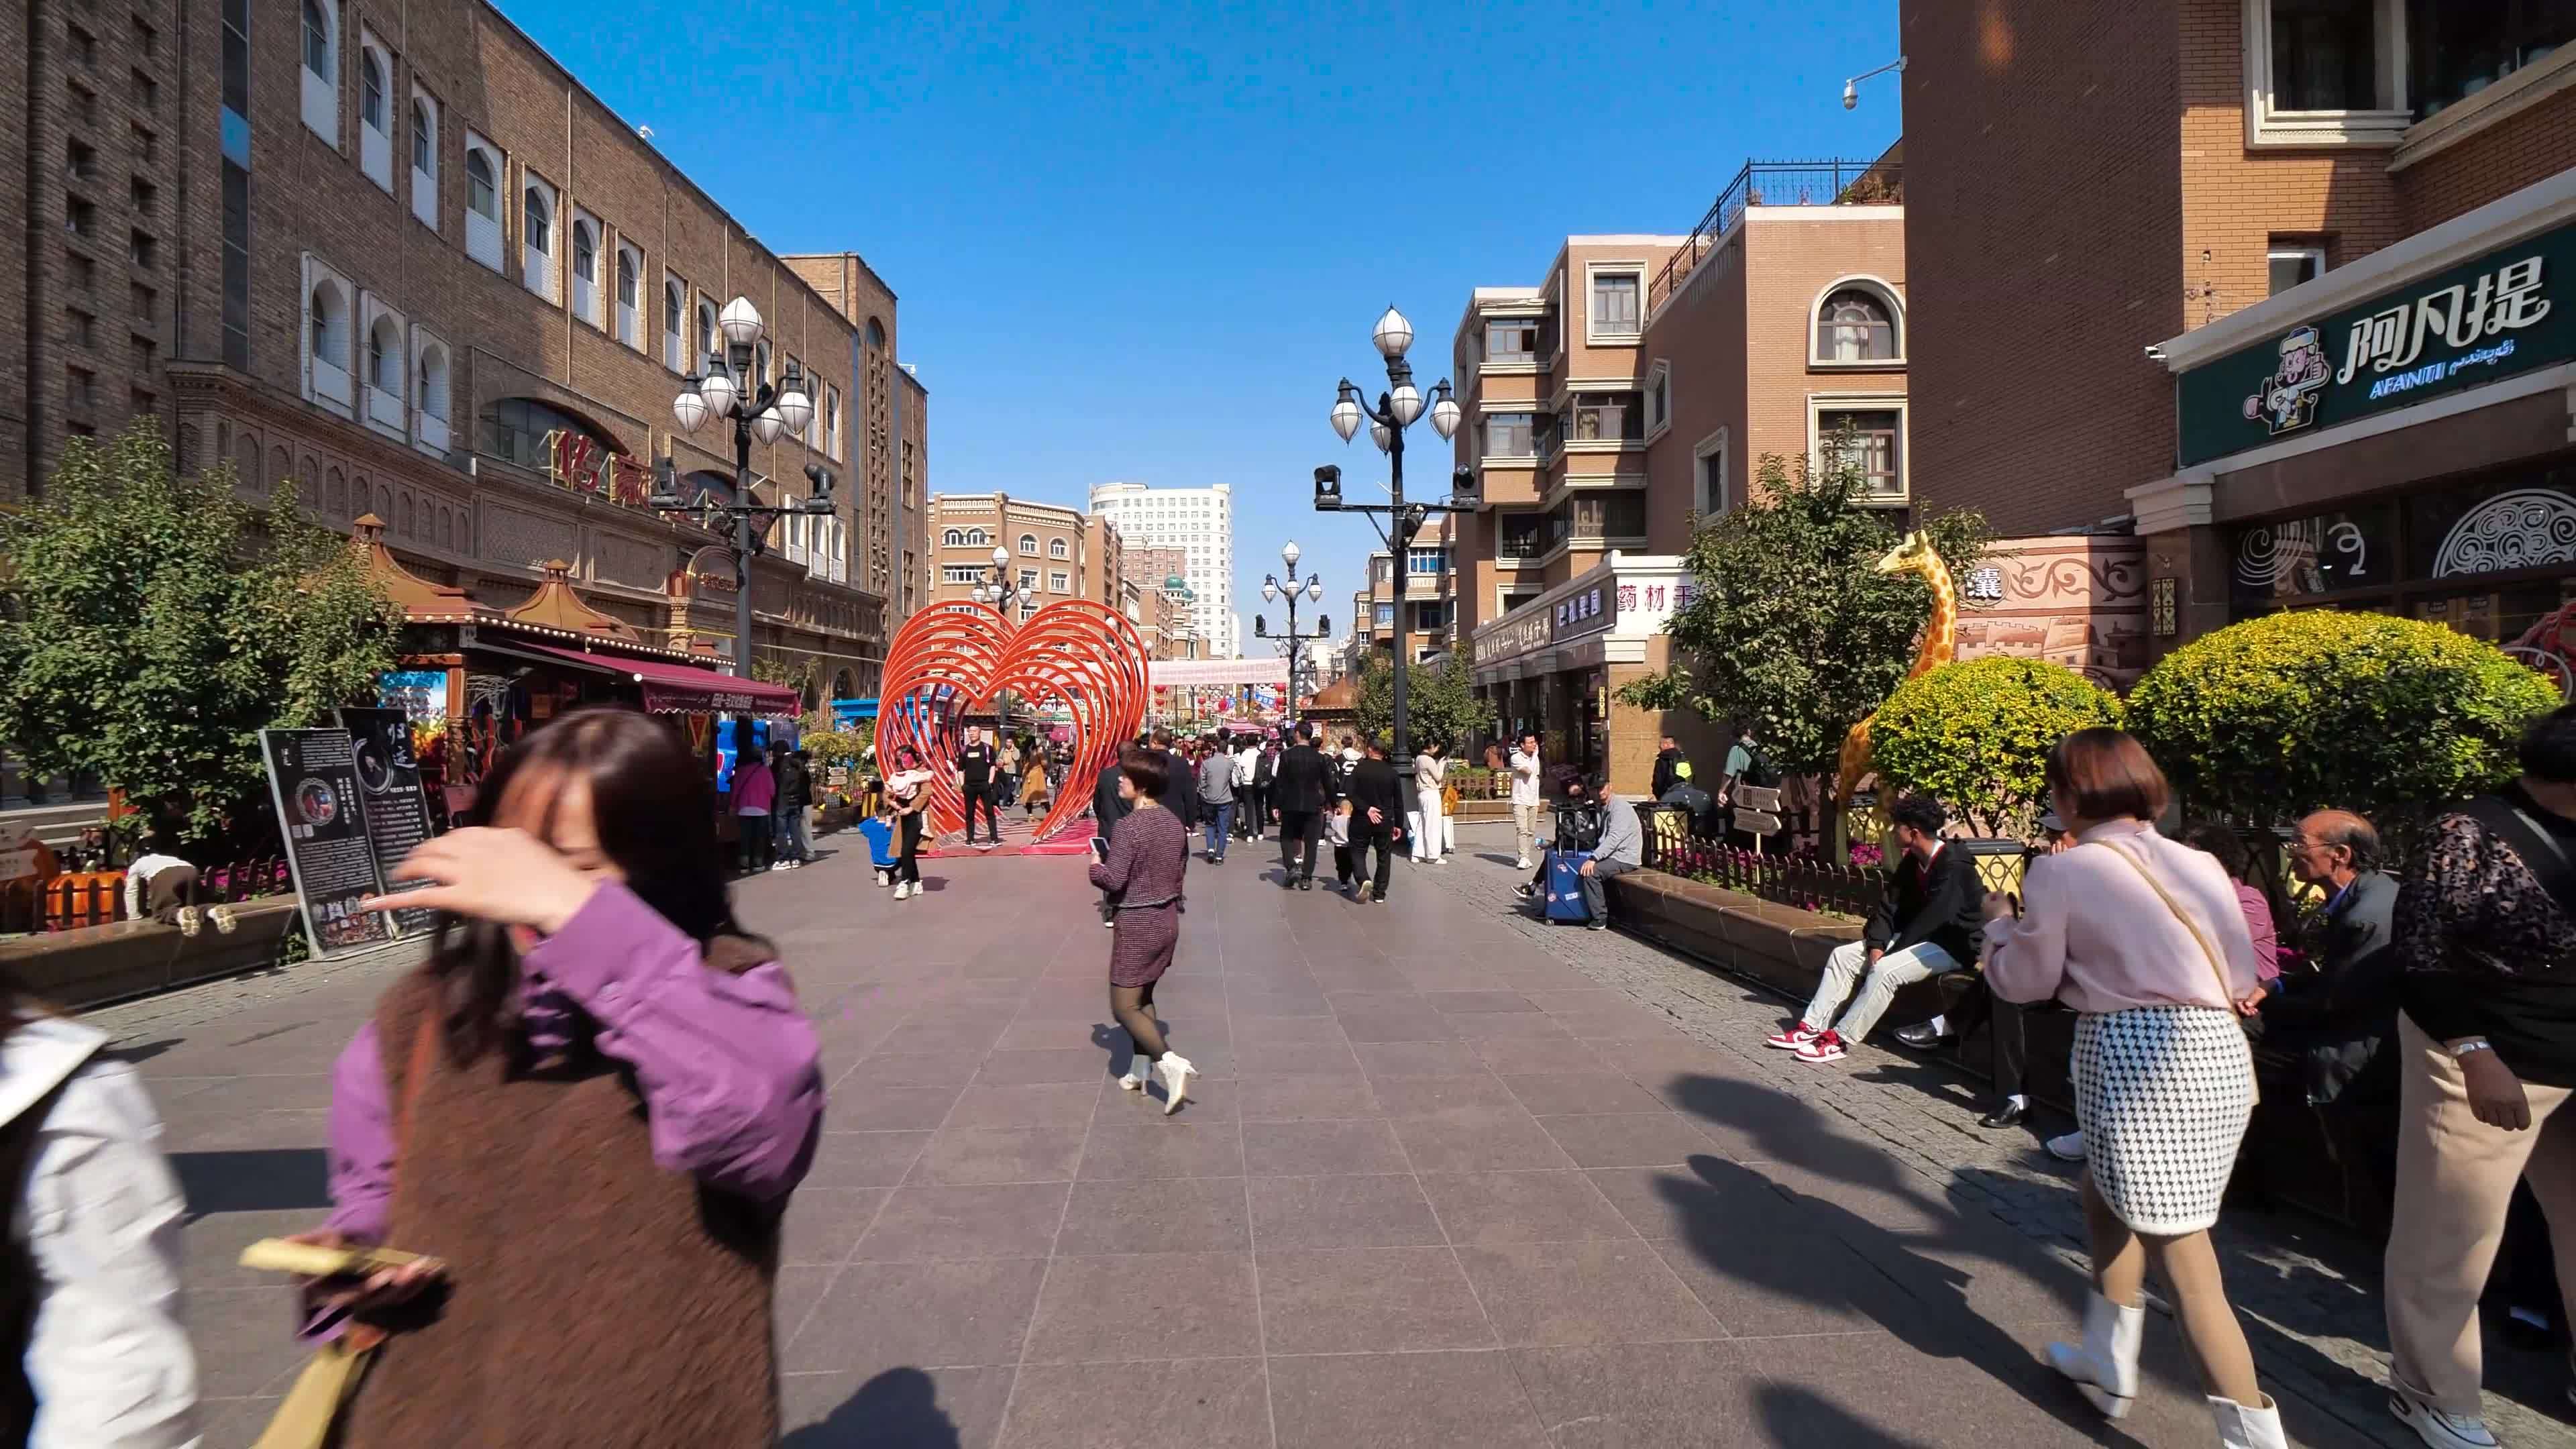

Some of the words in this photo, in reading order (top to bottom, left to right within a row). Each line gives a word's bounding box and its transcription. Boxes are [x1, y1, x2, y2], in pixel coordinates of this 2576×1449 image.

[2337, 256, 2551, 385] 阿凡提
[2369, 362, 2446, 399] AFANTI
